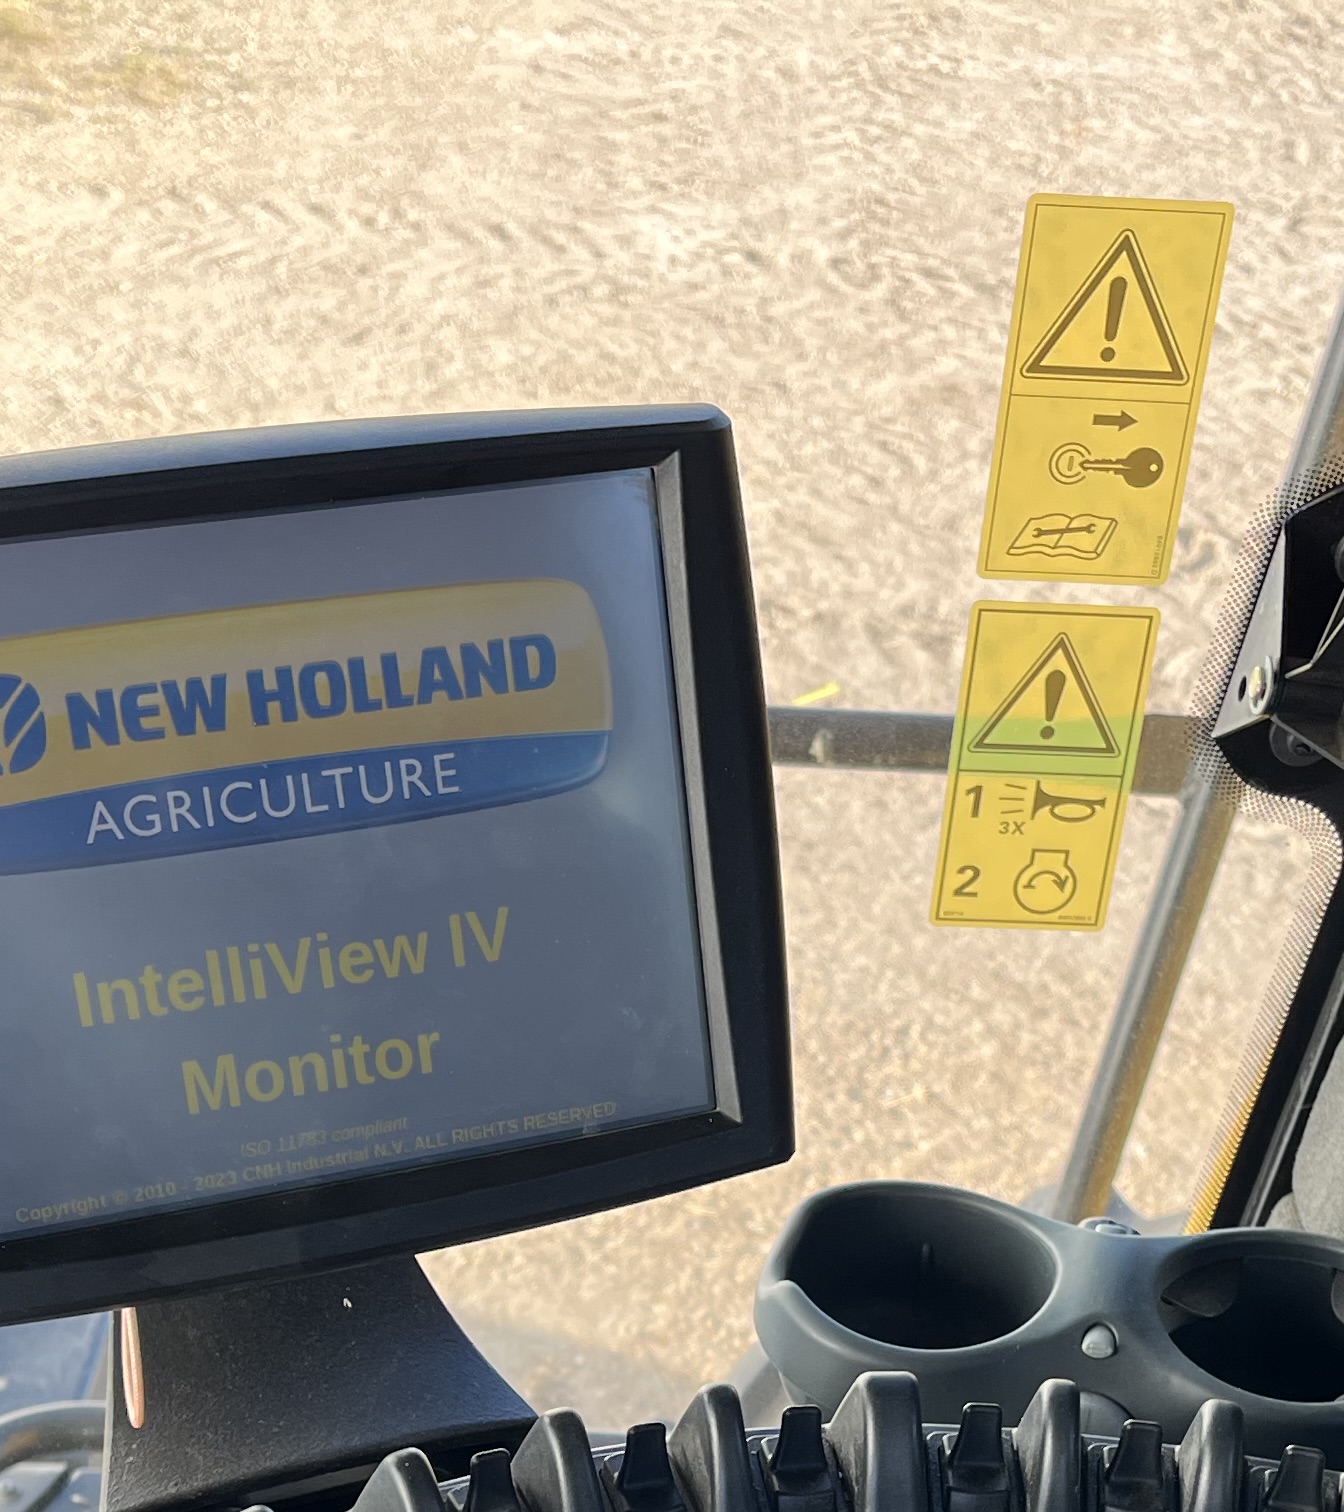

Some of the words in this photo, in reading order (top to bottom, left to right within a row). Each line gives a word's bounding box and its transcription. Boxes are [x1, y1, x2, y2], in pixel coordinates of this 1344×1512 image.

[65, 673, 227, 750] NEW
[247, 633, 557, 725] HOLLAND
[86, 752, 461, 845] AGRICULTURE
[965, 785, 983, 818] 1
[998, 821, 1026, 836] 3X
[952, 865, 982, 898] 2
[74, 930, 428, 1027] IntelliView
[448, 906, 510, 966] IV
[181, 1031, 441, 1115] Monitor
[16, 1194, 108, 1223] Copyright
[241, 1161, 282, 1182] CNH
[285, 1145, 370, 1174] Industrial
[414, 1133, 449, 1152] ALL
[452, 1120, 519, 1146] RIGHTS
[523, 1100, 617, 1132] RESERVED
